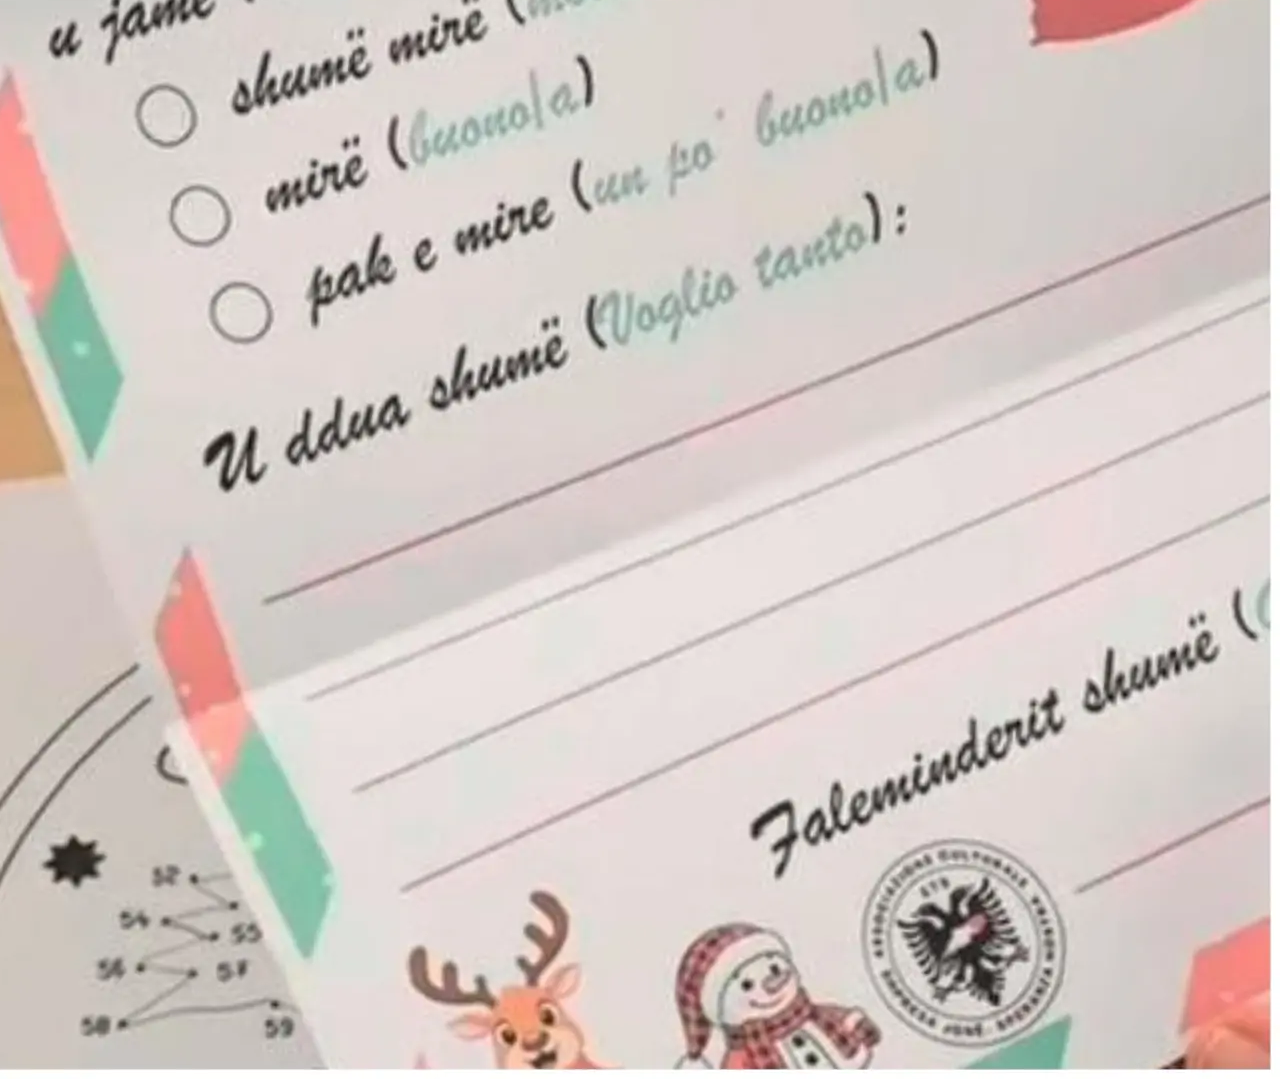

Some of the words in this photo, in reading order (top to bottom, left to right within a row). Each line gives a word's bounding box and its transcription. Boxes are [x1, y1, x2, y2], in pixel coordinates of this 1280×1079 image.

[47, 19, 82, 59] u
[229, 29, 373, 116] shumë
[265, 134, 370, 216] mirë
[307, 233, 396, 327] pak
[414, 241, 438, 273] e
[454, 197, 555, 258] mire
[571, 160, 647, 213] (un
[202, 425, 269, 493] U
[285, 364, 412, 468] ddua
[427, 317, 571, 410] shumë
[584, 262, 740, 353] (Voglio
[755, 191, 909, 292] tanto):
[749, 687, 1068, 881] Faleminderit
[1081, 611, 1222, 714] shumë
[151, 863, 183, 889] 52
[119, 908, 152, 932] 54
[230, 921, 264, 946] 55
[97, 957, 127, 982] 56
[216, 958, 249, 983] 57
[81, 1015, 112, 1039] 58
[264, 1015, 297, 1040] 59
